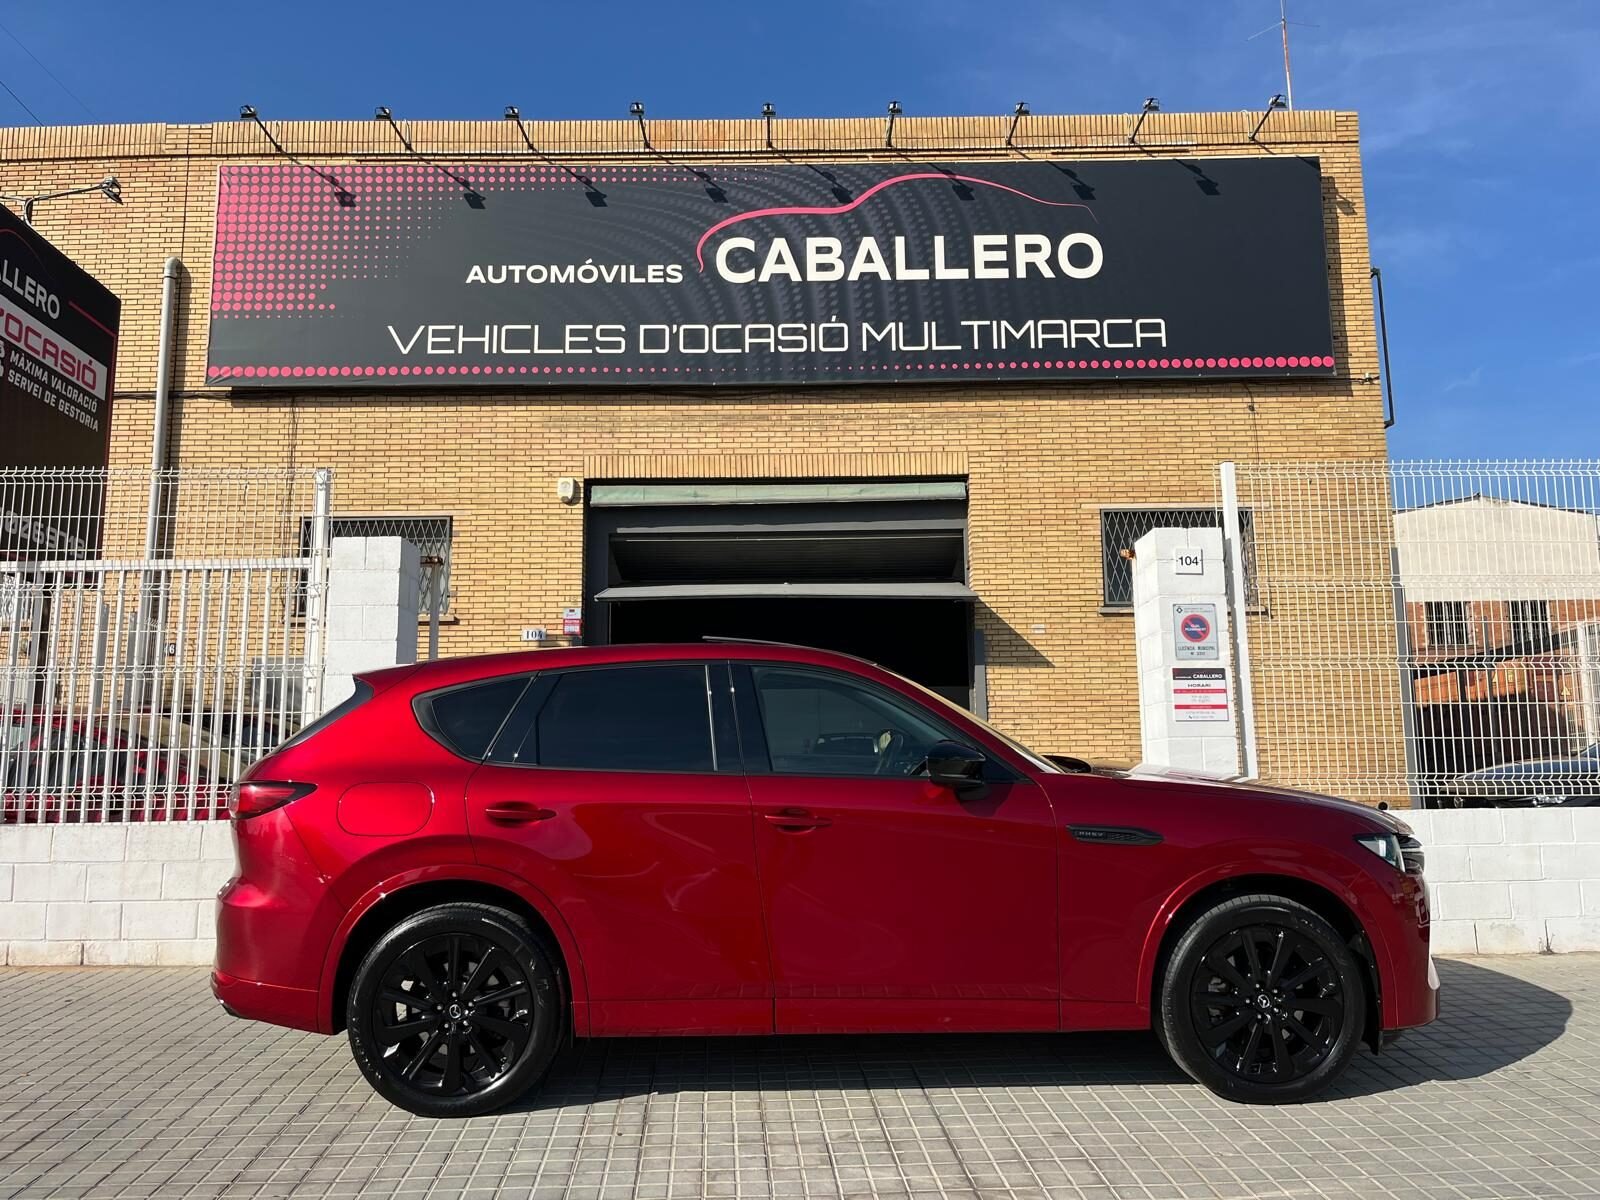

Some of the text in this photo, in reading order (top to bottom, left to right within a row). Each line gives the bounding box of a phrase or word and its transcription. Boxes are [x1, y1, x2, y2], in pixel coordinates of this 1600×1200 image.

[466, 232, 1104, 284] AUTOMÓVILES CABALLERO
[0, 259, 60, 320] LLERO
[387, 315, 1167, 355] VEHICLES D'OCASIÓ MULTIMARCA
[8, 369, 99, 432] SERVEI DE GESTORIA
[10, 350, 49, 385] MÀXIMA
[51, 374, 98, 414] VALORACIÓ
[1179, 556, 1199, 566] 104
